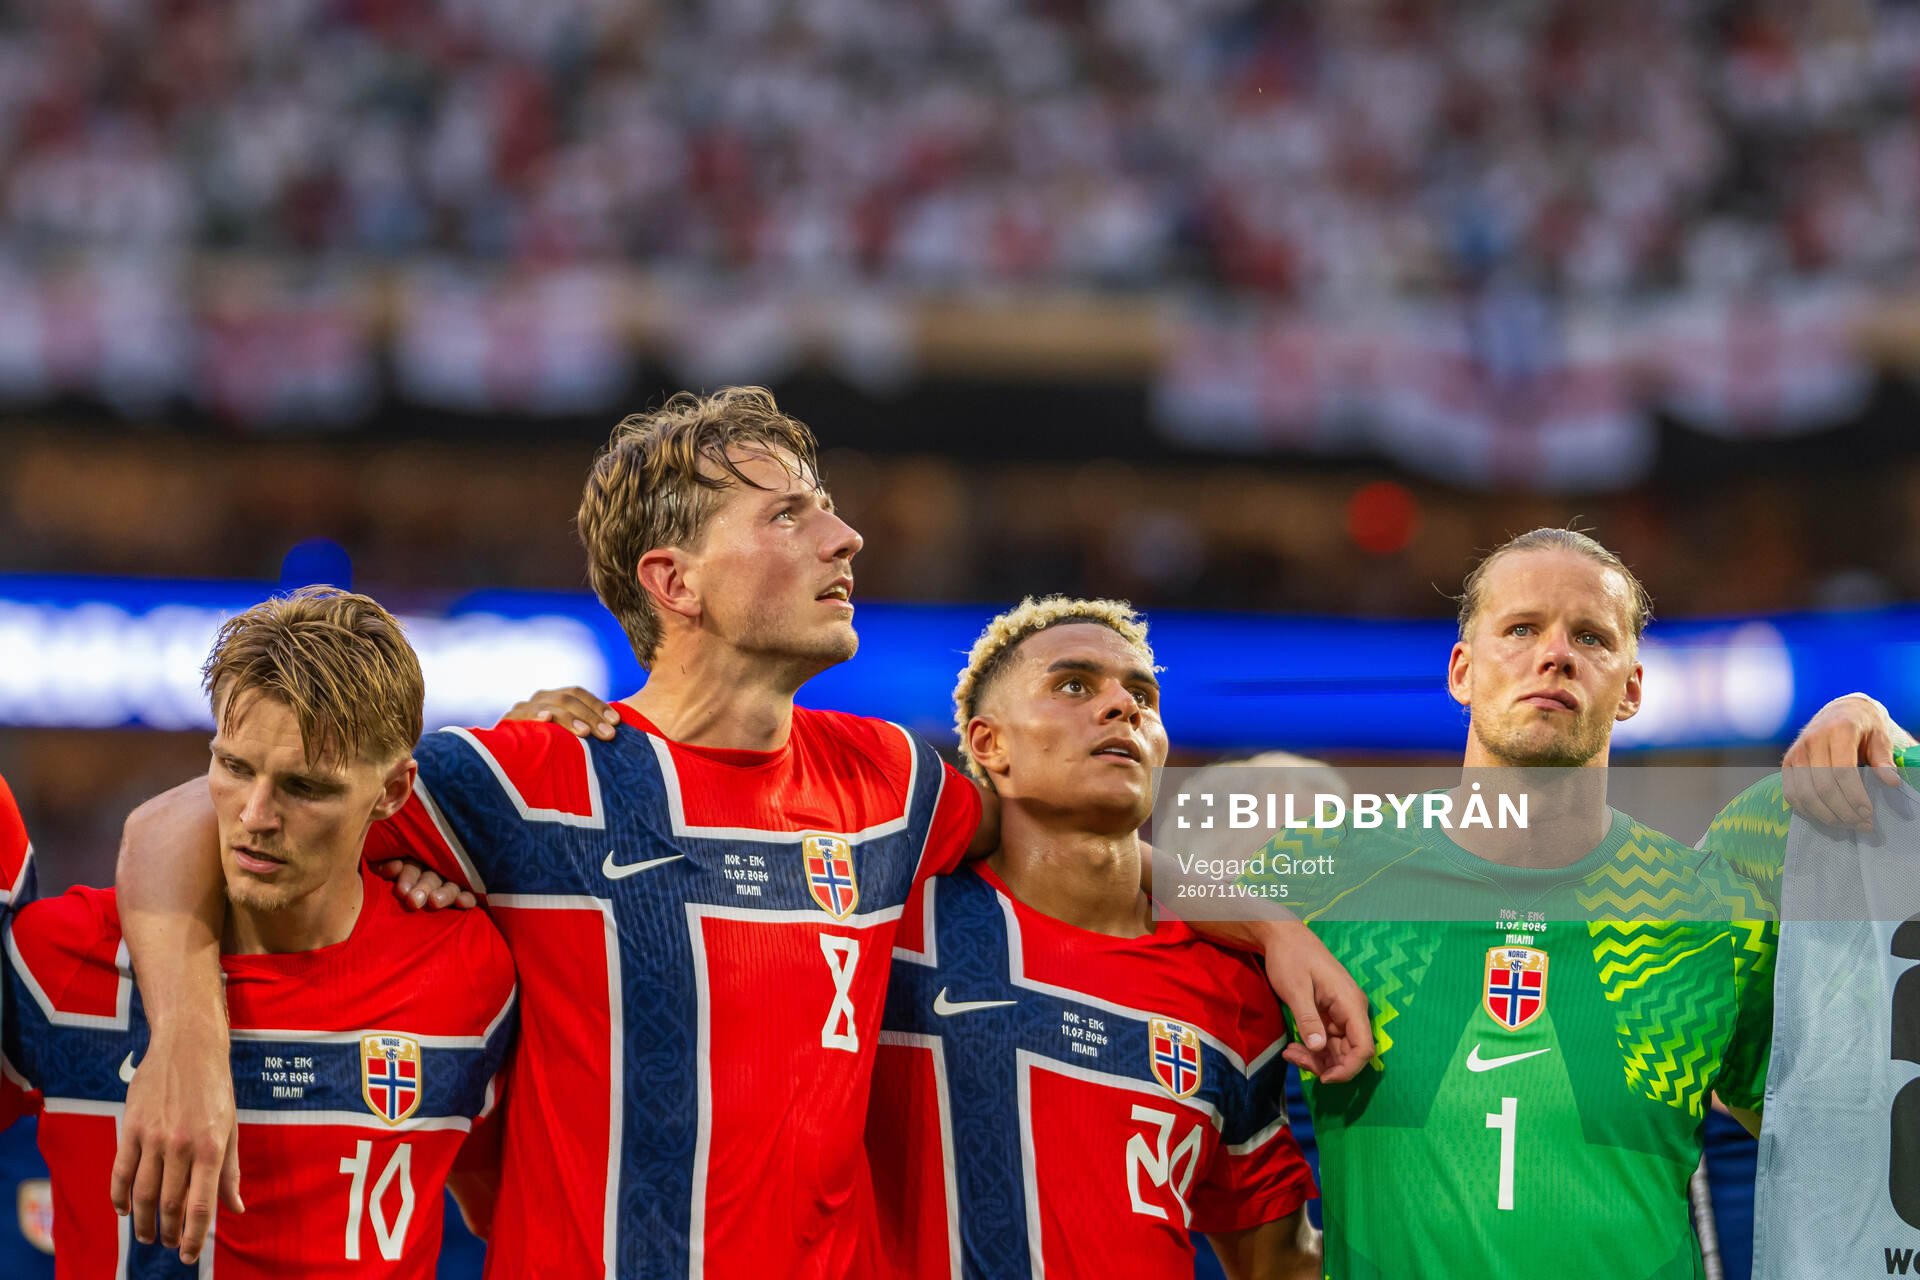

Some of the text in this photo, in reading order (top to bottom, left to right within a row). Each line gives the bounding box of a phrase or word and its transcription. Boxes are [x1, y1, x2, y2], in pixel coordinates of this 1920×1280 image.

[724, 854, 741, 865] NOR
[749, 855, 765, 867] ENG
[736, 884, 762, 897] MIAMI
[1500, 909, 1517, 920] NOR
[1527, 911, 1545, 921] ENG
[1505, 934, 1534, 945] MIAMI
[1508, 950, 1528, 959] NORGE
[819, 932, 860, 1054] 8
[1063, 1011, 1080, 1024] NOR
[1088, 1018, 1104, 1032] ENG
[381, 1037, 400, 1047] NORGE
[1071, 1041, 1098, 1057] MIAMI
[265, 1056, 283, 1069] NOR
[294, 1057, 312, 1069] ENG
[272, 1085, 303, 1098] MIAMI
[1485, 1097, 1518, 1210] 1
[1126, 1104, 1204, 1230] 20
[339, 1140, 415, 1261] 10
[1884, 1247, 1920, 1275] W
